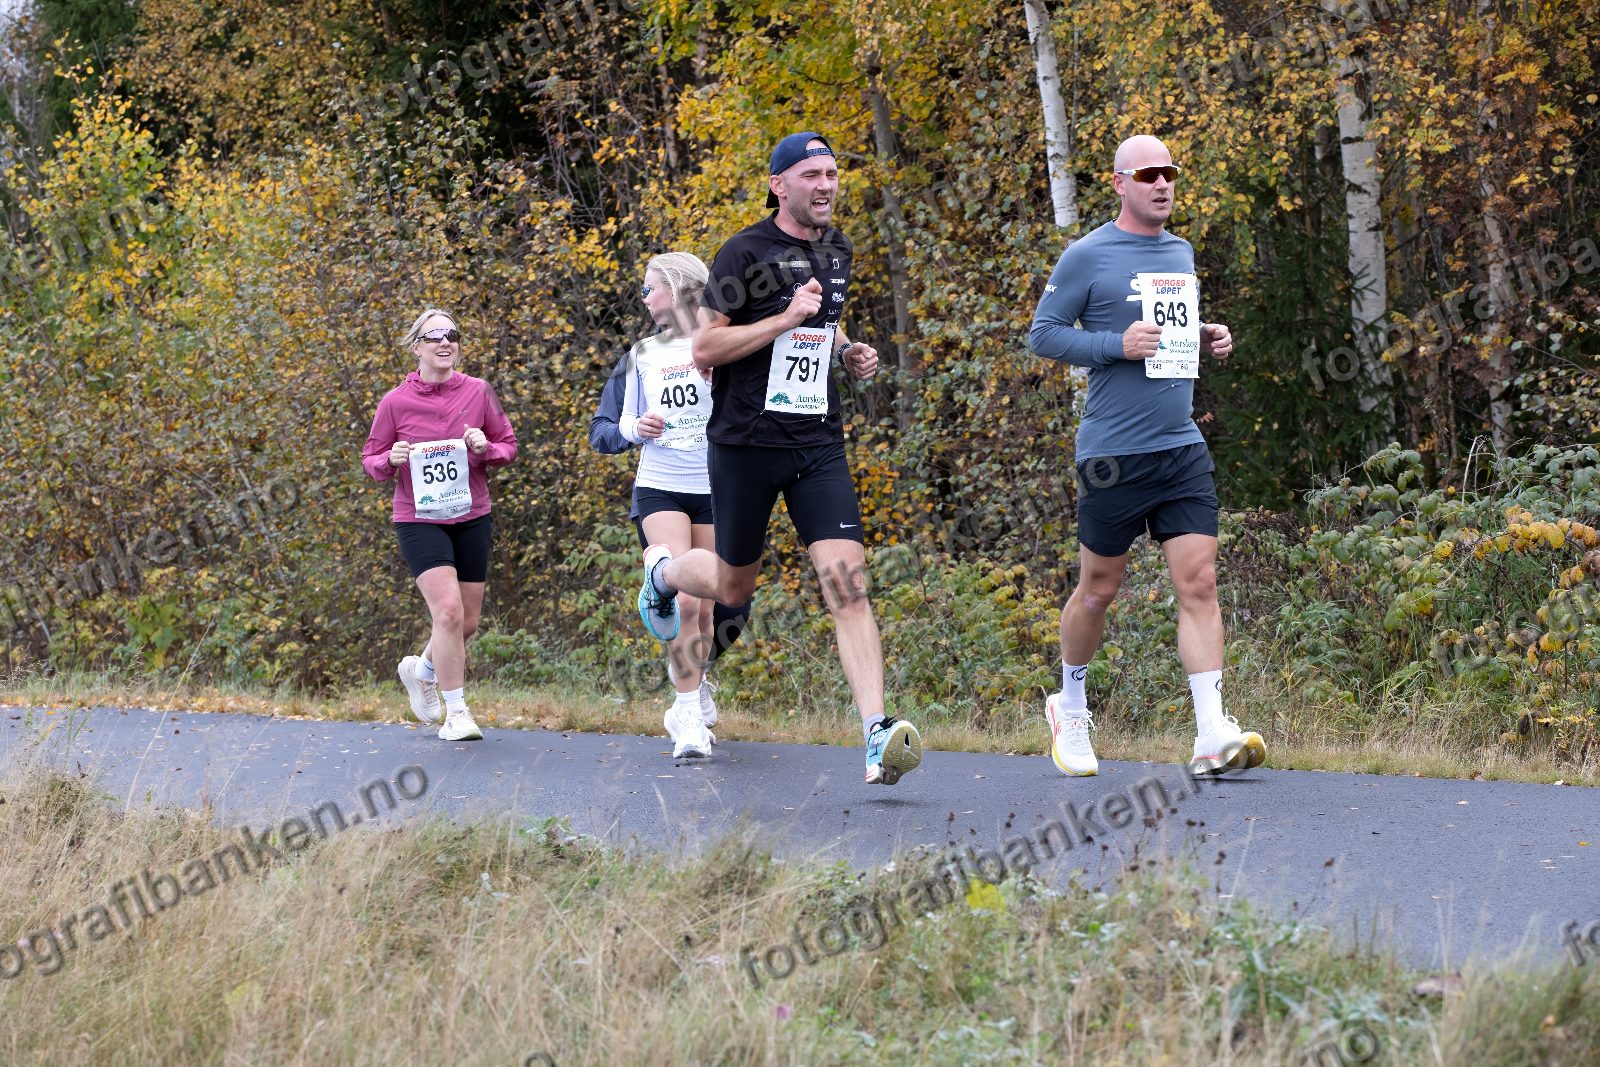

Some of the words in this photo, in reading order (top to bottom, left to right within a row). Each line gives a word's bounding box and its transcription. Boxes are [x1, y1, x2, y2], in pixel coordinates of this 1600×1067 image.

[1152, 279, 1186, 287] NORGES
[1156, 287, 1182, 295] LØPET
[1153, 301, 1188, 327] 643
[790, 332, 827, 343] NORGES
[793, 341, 822, 351] LØPET
[1169, 339, 1198, 351] Aurskog
[785, 355, 820, 383] 791
[663, 370, 691, 381] LØPET
[660, 383, 699, 409] 403
[795, 394, 826, 406] Aurskog
[678, 414, 711, 426] Aursko
[421, 444, 456, 454] NORGES
[424, 450, 451, 460] LØPET
[422, 460, 458, 485] 536
